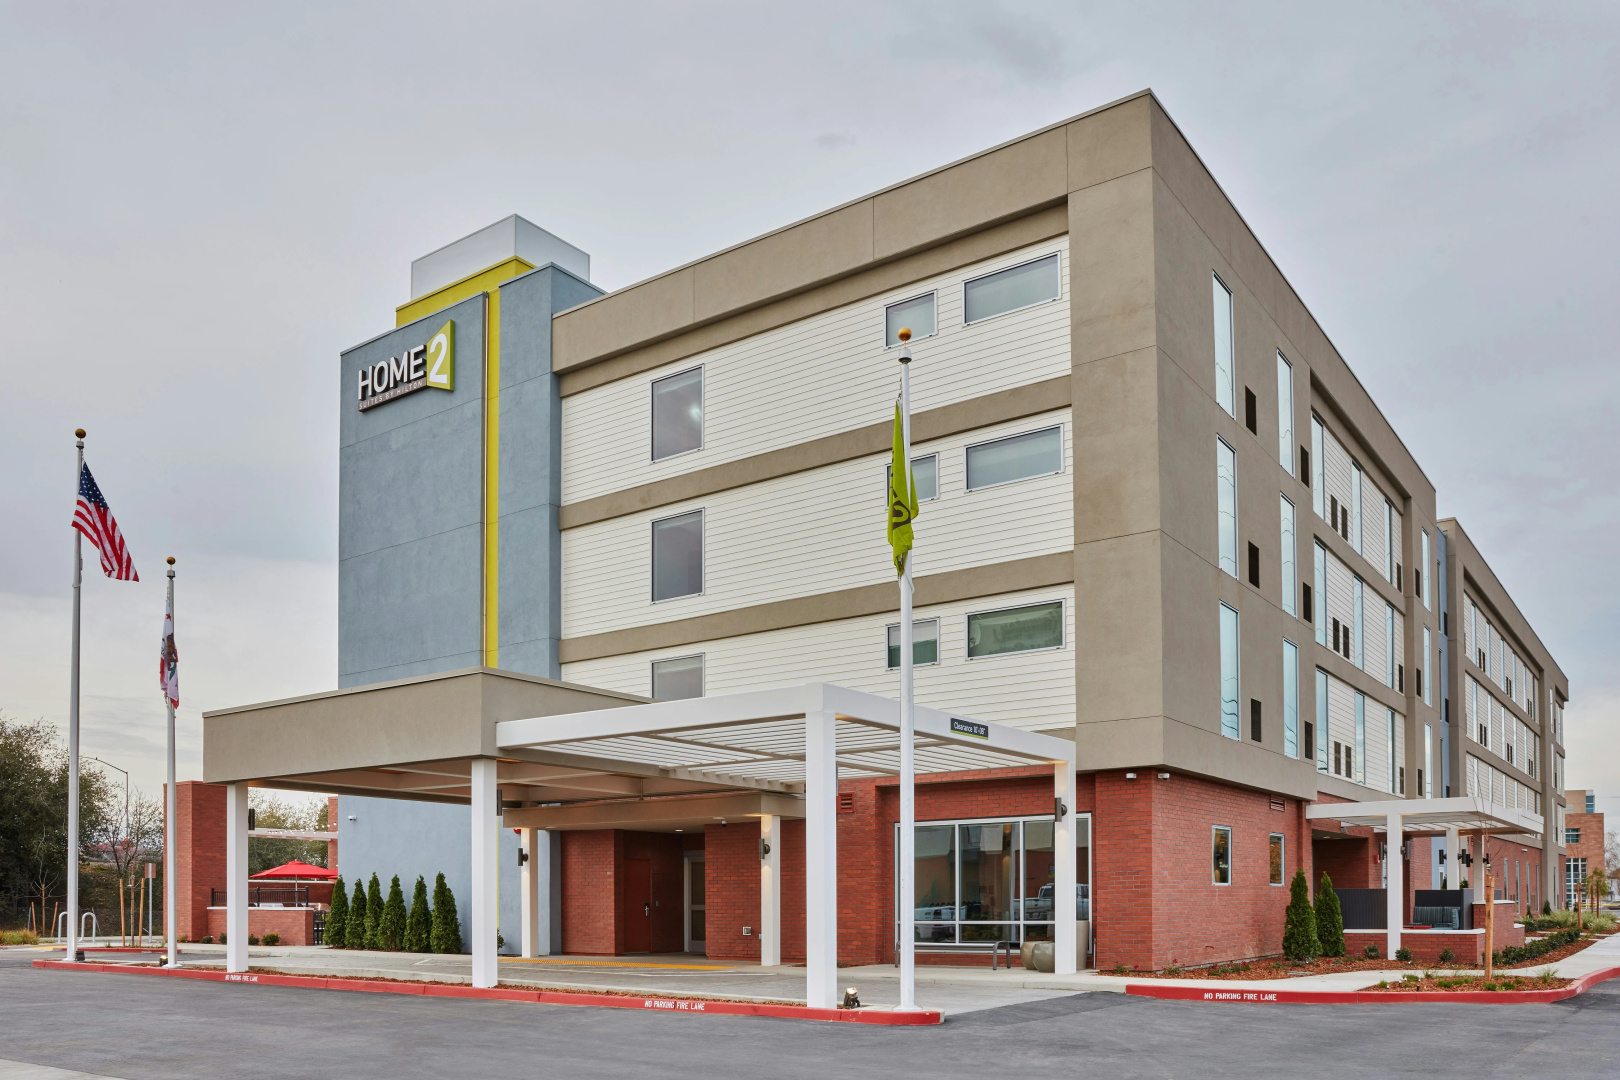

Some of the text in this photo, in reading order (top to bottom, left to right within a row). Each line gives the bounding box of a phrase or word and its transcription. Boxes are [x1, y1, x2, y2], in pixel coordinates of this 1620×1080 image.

[358, 333, 447, 400] HOME 2
[359, 381, 422, 410] SUITES BY HILTON
[953, 721, 973, 733] Clearance
[1204, 992, 1213, 1000] NO
[1215, 992, 1241, 1000] PARKING
[1260, 993, 1277, 1001] LANE
[644, 1000, 705, 1011] NO PARKING FIRE LANE
